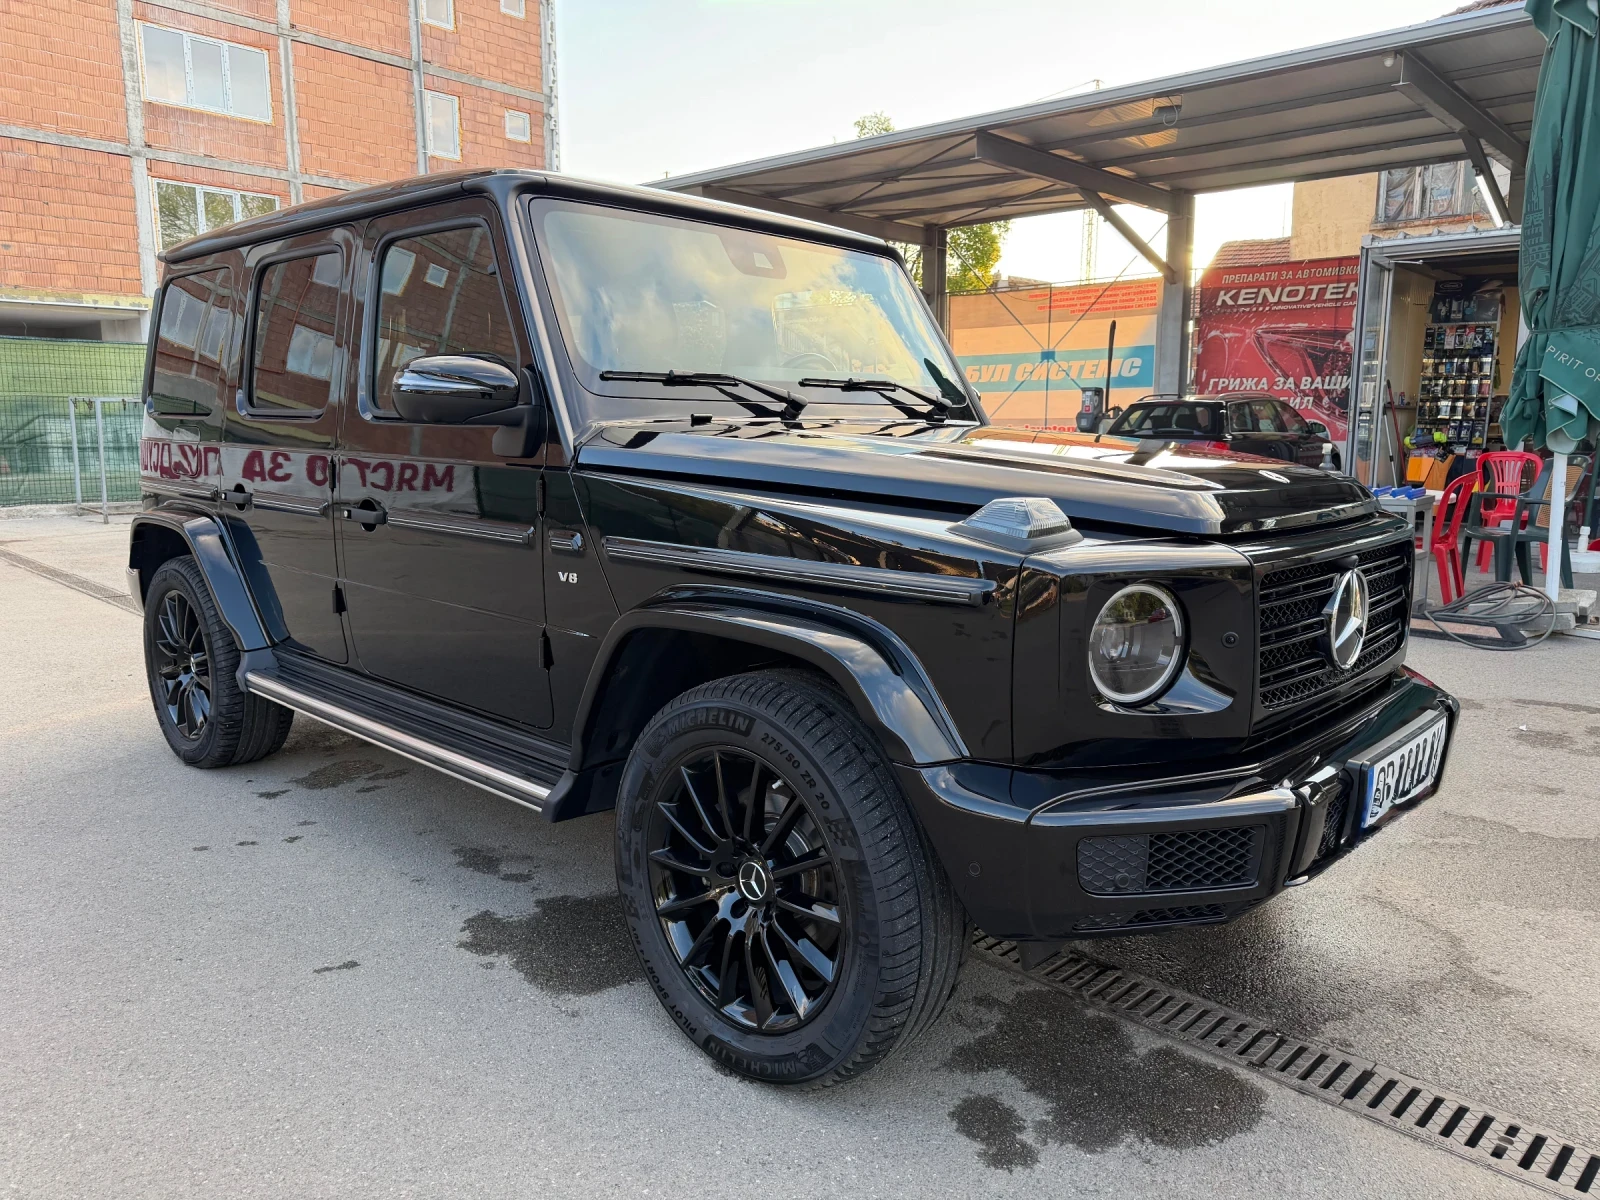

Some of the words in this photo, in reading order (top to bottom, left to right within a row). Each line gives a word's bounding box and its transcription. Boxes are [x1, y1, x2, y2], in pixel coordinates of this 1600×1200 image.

[1222, 271, 1278, 284] ПРЕПАРАТИ
[1281, 269, 1293, 280] ЗА
[1296, 265, 1359, 278] АВТОМИВКИ
[964, 364, 1012, 383] БУЛ
[1208, 377, 1268, 391] ГРИЖА
[1273, 376, 1295, 390] ЗА
[557, 571, 578, 584] V8
[668, 707, 750, 736] MICHELIN
[761, 732, 801, 770] 275/50
[800, 770, 816, 790] ZR
[815, 792, 830, 811] 20
[642, 957, 670, 1000] SPORT
[669, 1003, 698, 1037] PILOT
